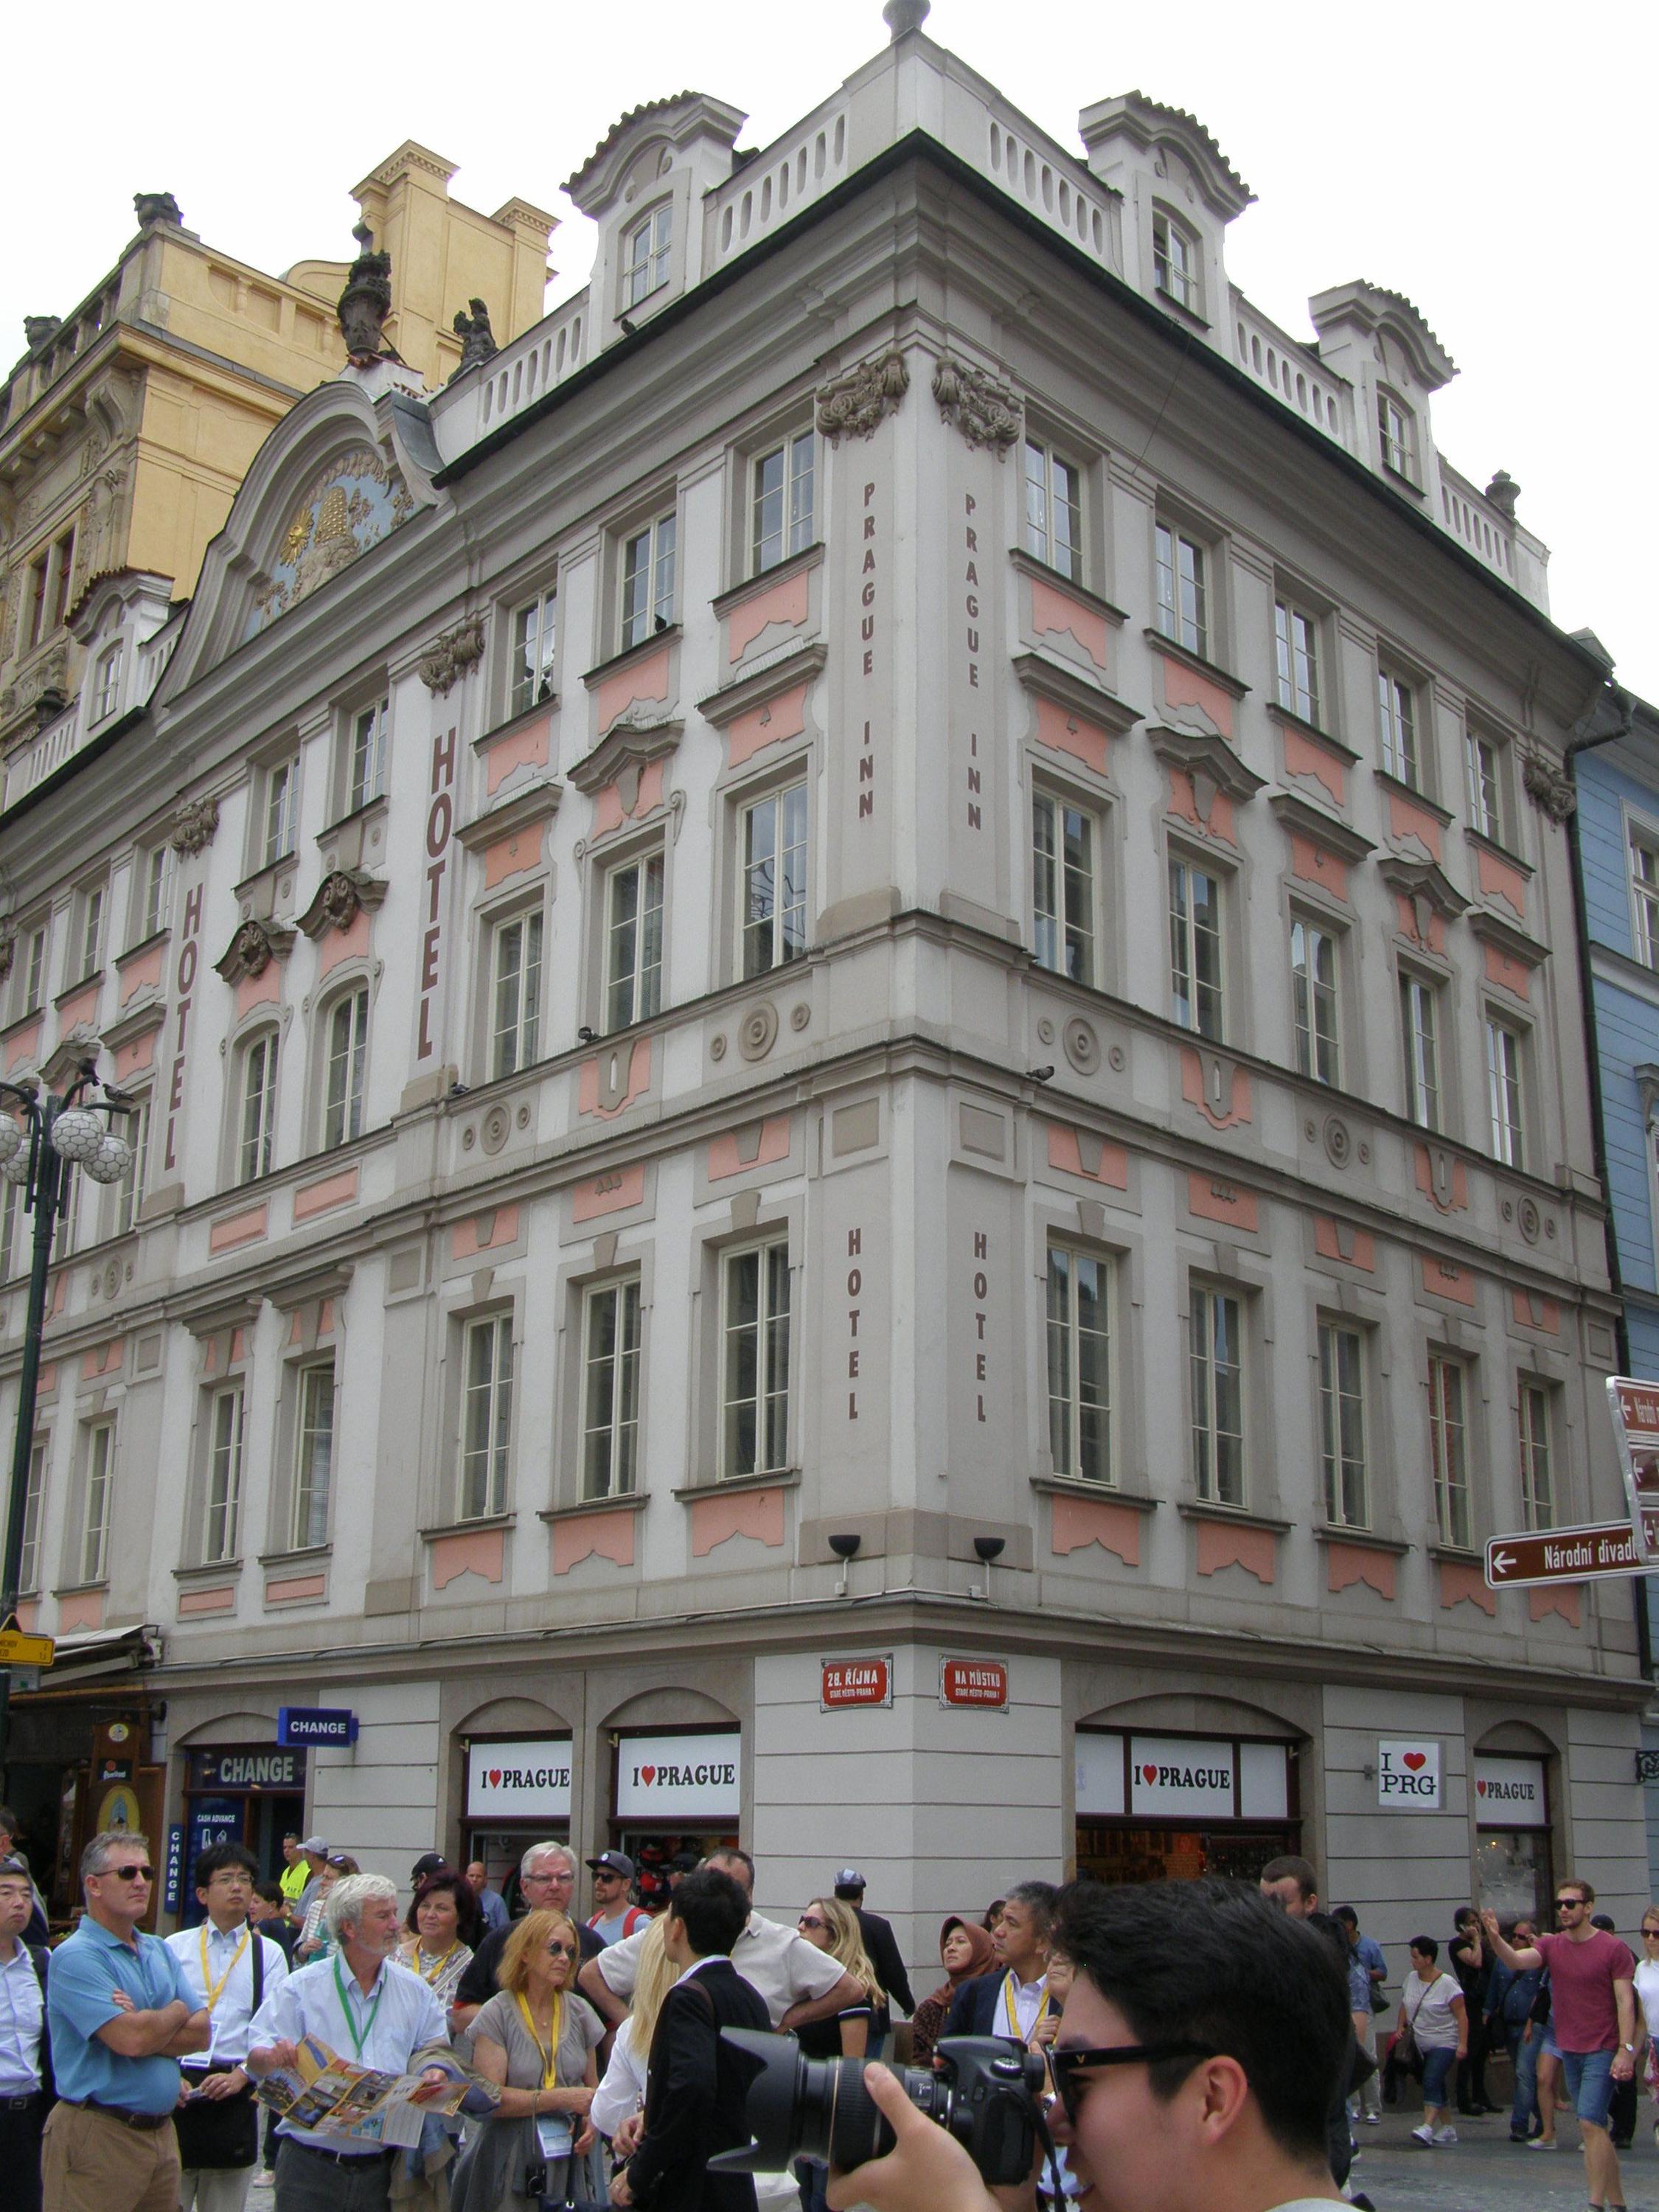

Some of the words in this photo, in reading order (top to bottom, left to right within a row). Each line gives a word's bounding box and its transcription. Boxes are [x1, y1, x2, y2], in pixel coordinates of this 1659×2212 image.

[862, 482, 876, 676] PRAGUE
[965, 493, 979, 689] PRAGUE
[859, 720, 874, 819] INN
[967, 733, 981, 831] INN
[417, 726, 456, 1061] HOTEL
[164, 882, 204, 1171] HOTEL
[847, 1228, 862, 1420] HOTEL
[973, 1231, 987, 1423] HOTEL
[1545, 1541, 1592, 1570] Národní
[827, 1672, 842, 1687] 28.
[845, 1668, 878, 1686] ŘÍJNA
[955, 1670, 967, 1685] NA
[969, 1669, 1001, 1687] MŮSTKU
[290, 1721, 347, 1734] CHANGE
[220, 1756, 294, 1783] CHANGE
[632, 1767, 639, 1787] I
[656, 1764, 735, 1787] PRAGUE
[1381, 1753, 1391, 1771] I
[481, 1770, 487, 1789] I
[502, 1768, 570, 1789] PRAGUE
[1134, 1765, 1141, 1785] I
[1158, 1767, 1231, 1790] PRAGUE
[1381, 1774, 1437, 1795] PRG
[1487, 1781, 1534, 1801] PRAGUE
[197, 1814, 212, 1823] CASH
[212, 1814, 235, 1823] ADVANCE
[167, 1832, 180, 1902] CHANGE
